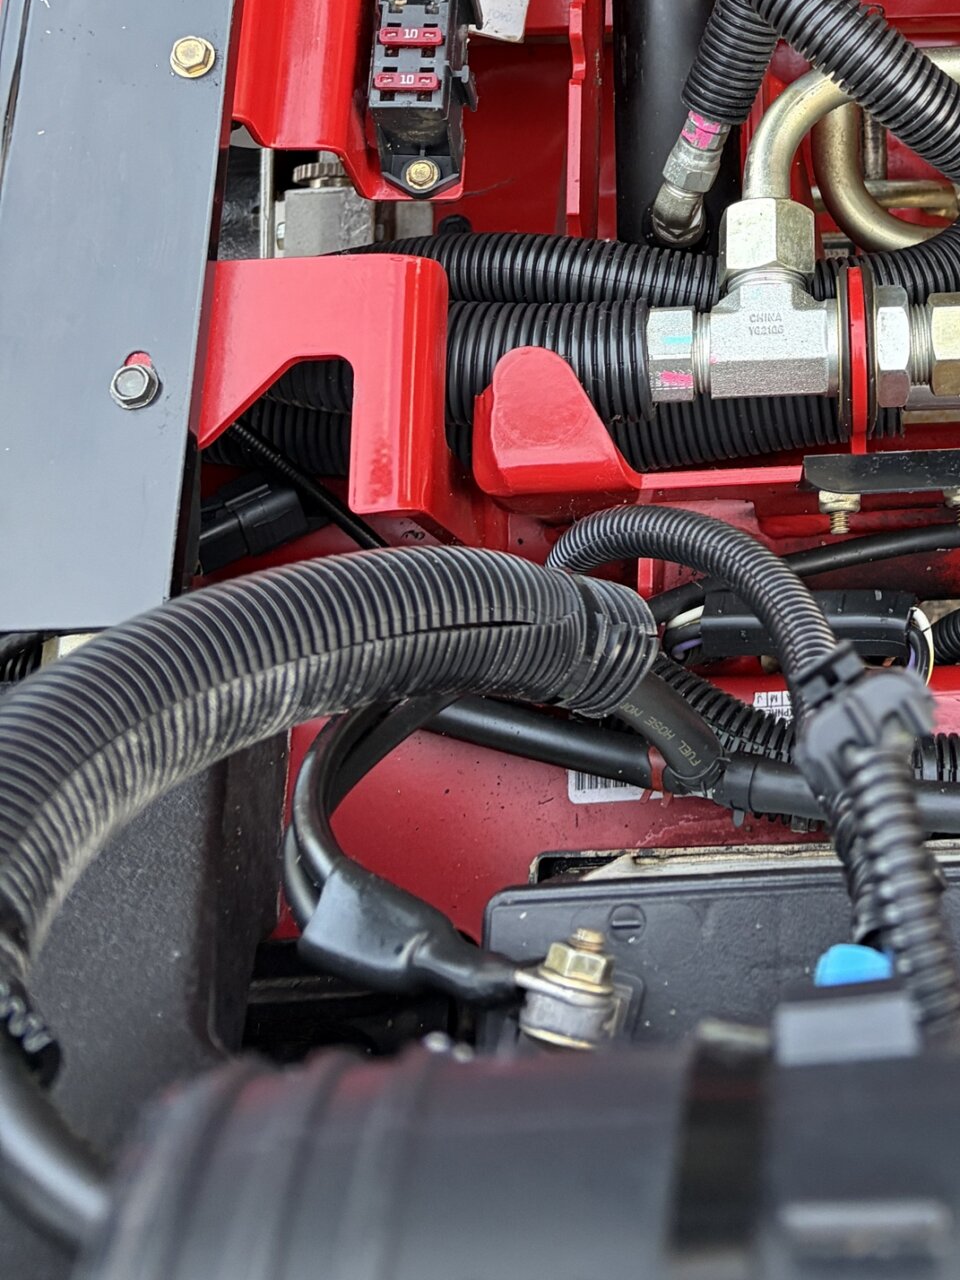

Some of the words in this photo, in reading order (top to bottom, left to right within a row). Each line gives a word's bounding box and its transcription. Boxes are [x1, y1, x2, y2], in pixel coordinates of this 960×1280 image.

[403, 28, 419, 39] 10
[400, 74, 415, 85] 10
[749, 311, 783, 323] CHINA
[644, 716, 675, 741] HOSE
[677, 739, 702, 767] FUEL
